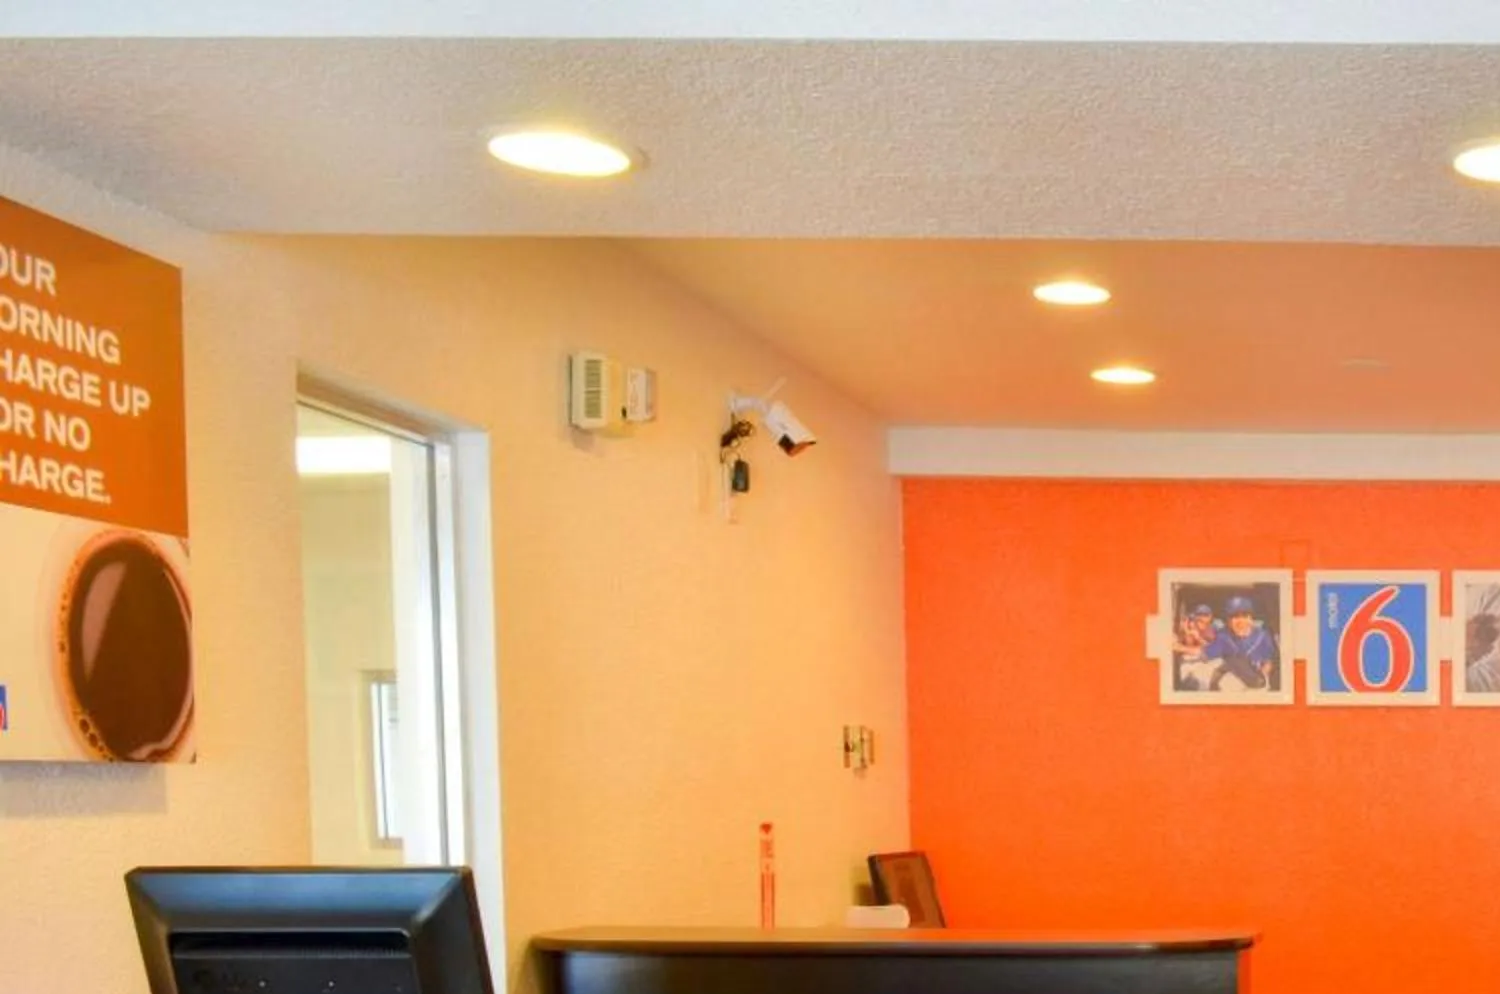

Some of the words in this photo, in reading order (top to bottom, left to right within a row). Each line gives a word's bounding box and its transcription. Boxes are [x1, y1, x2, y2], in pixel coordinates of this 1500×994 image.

[109, 380, 151, 417] UP
[44, 408, 91, 452] NO
[1337, 585, 1414, 692] 6
